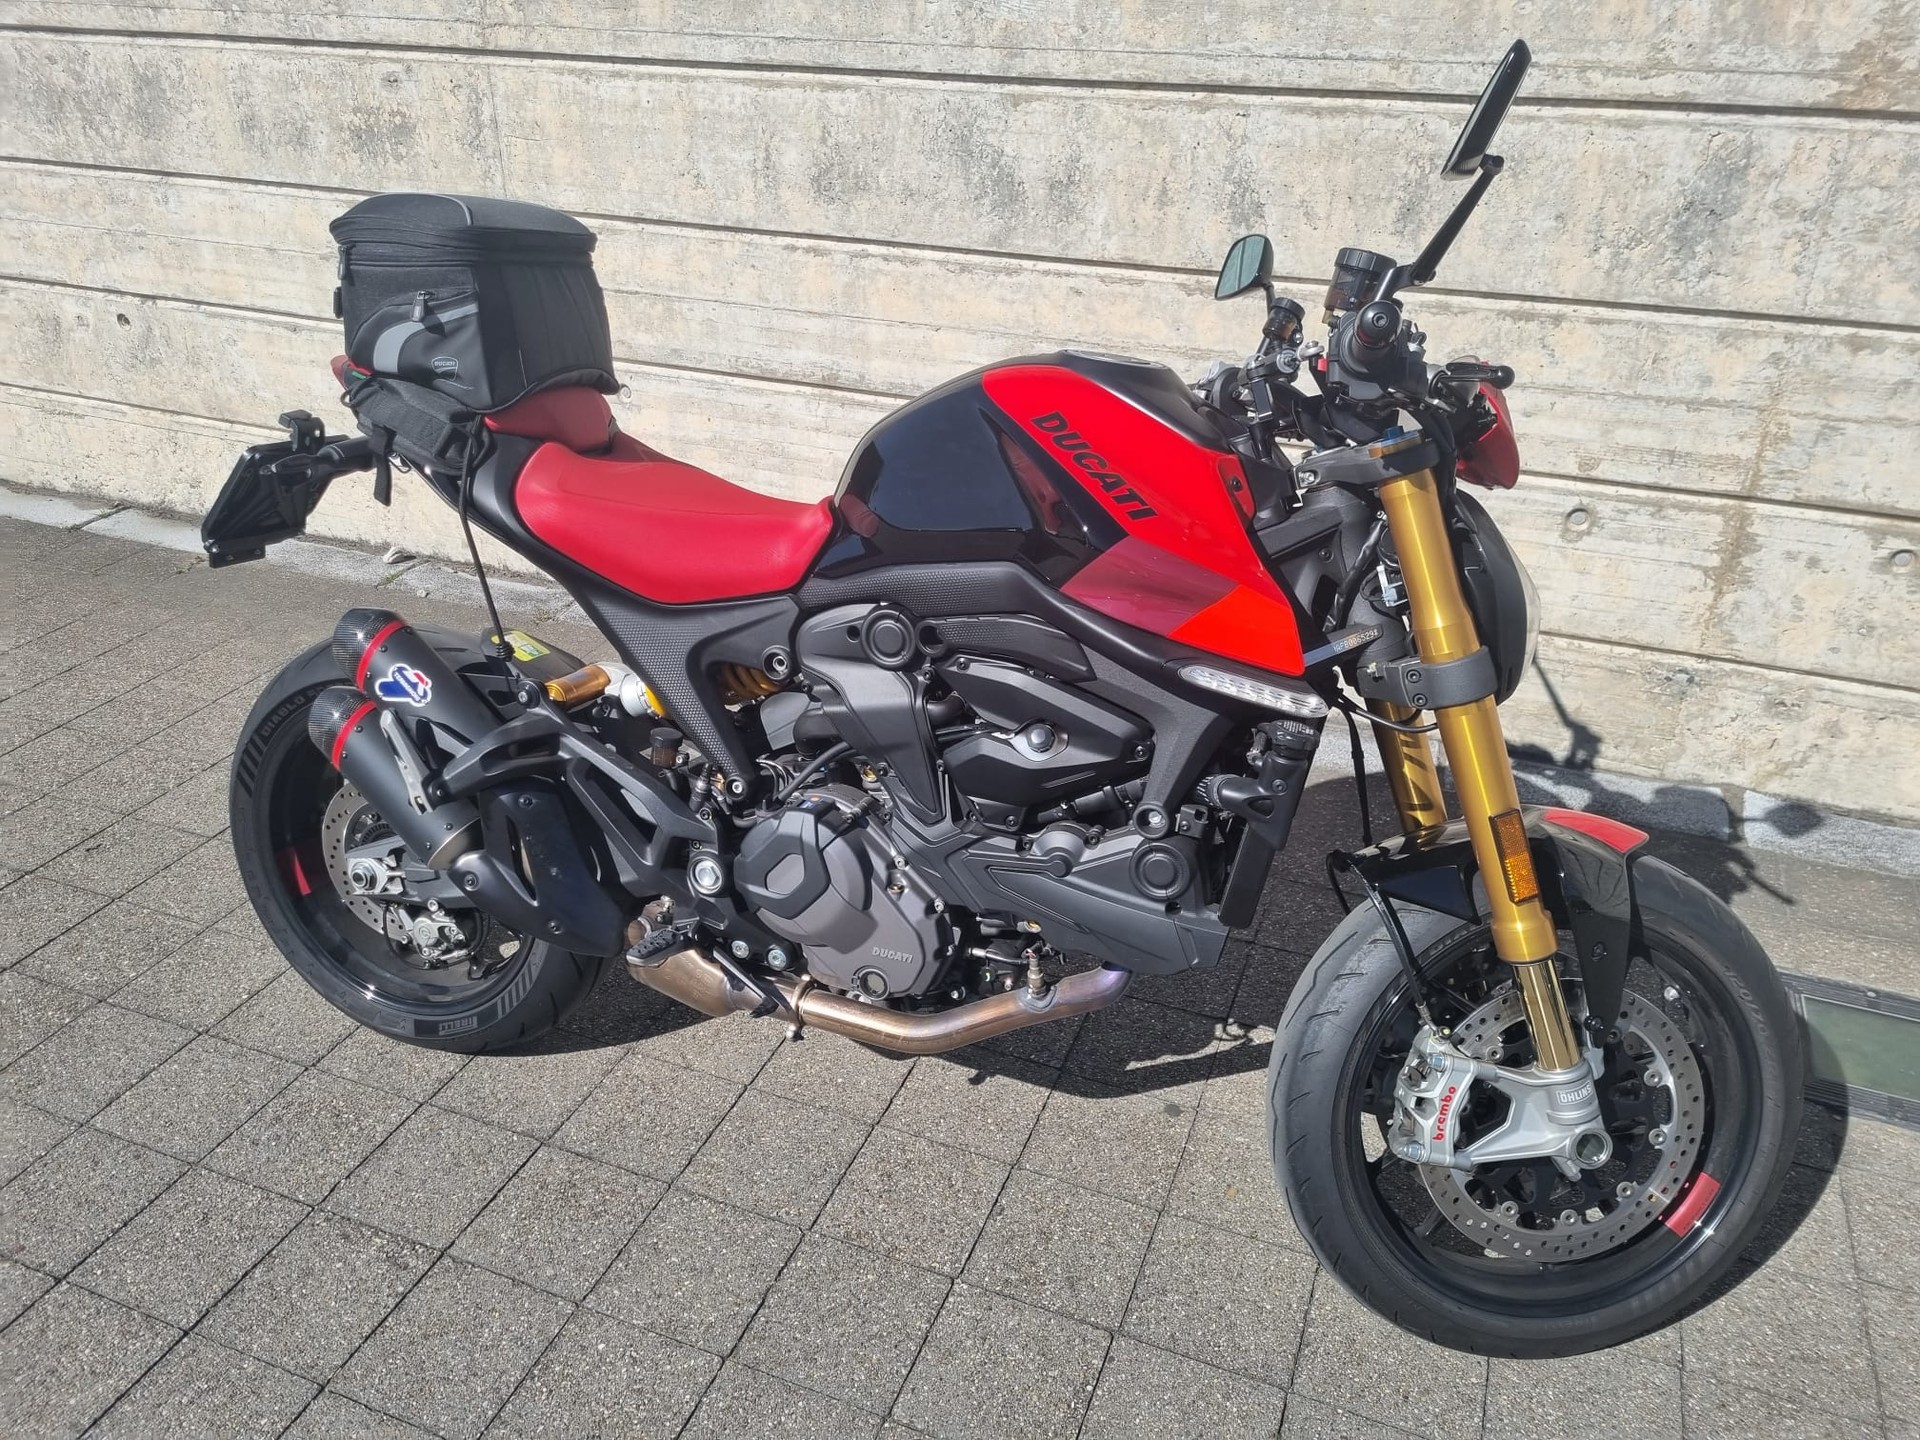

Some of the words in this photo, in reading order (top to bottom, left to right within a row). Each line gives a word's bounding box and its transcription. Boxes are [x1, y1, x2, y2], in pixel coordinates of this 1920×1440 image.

[1030, 410, 1158, 521] DUCATI
[261, 695, 306, 737] DIABLO
[872, 946, 913, 963] DUCATI
[438, 1016, 478, 1036] PIRELLI
[1433, 1086, 1457, 1141] brembo
